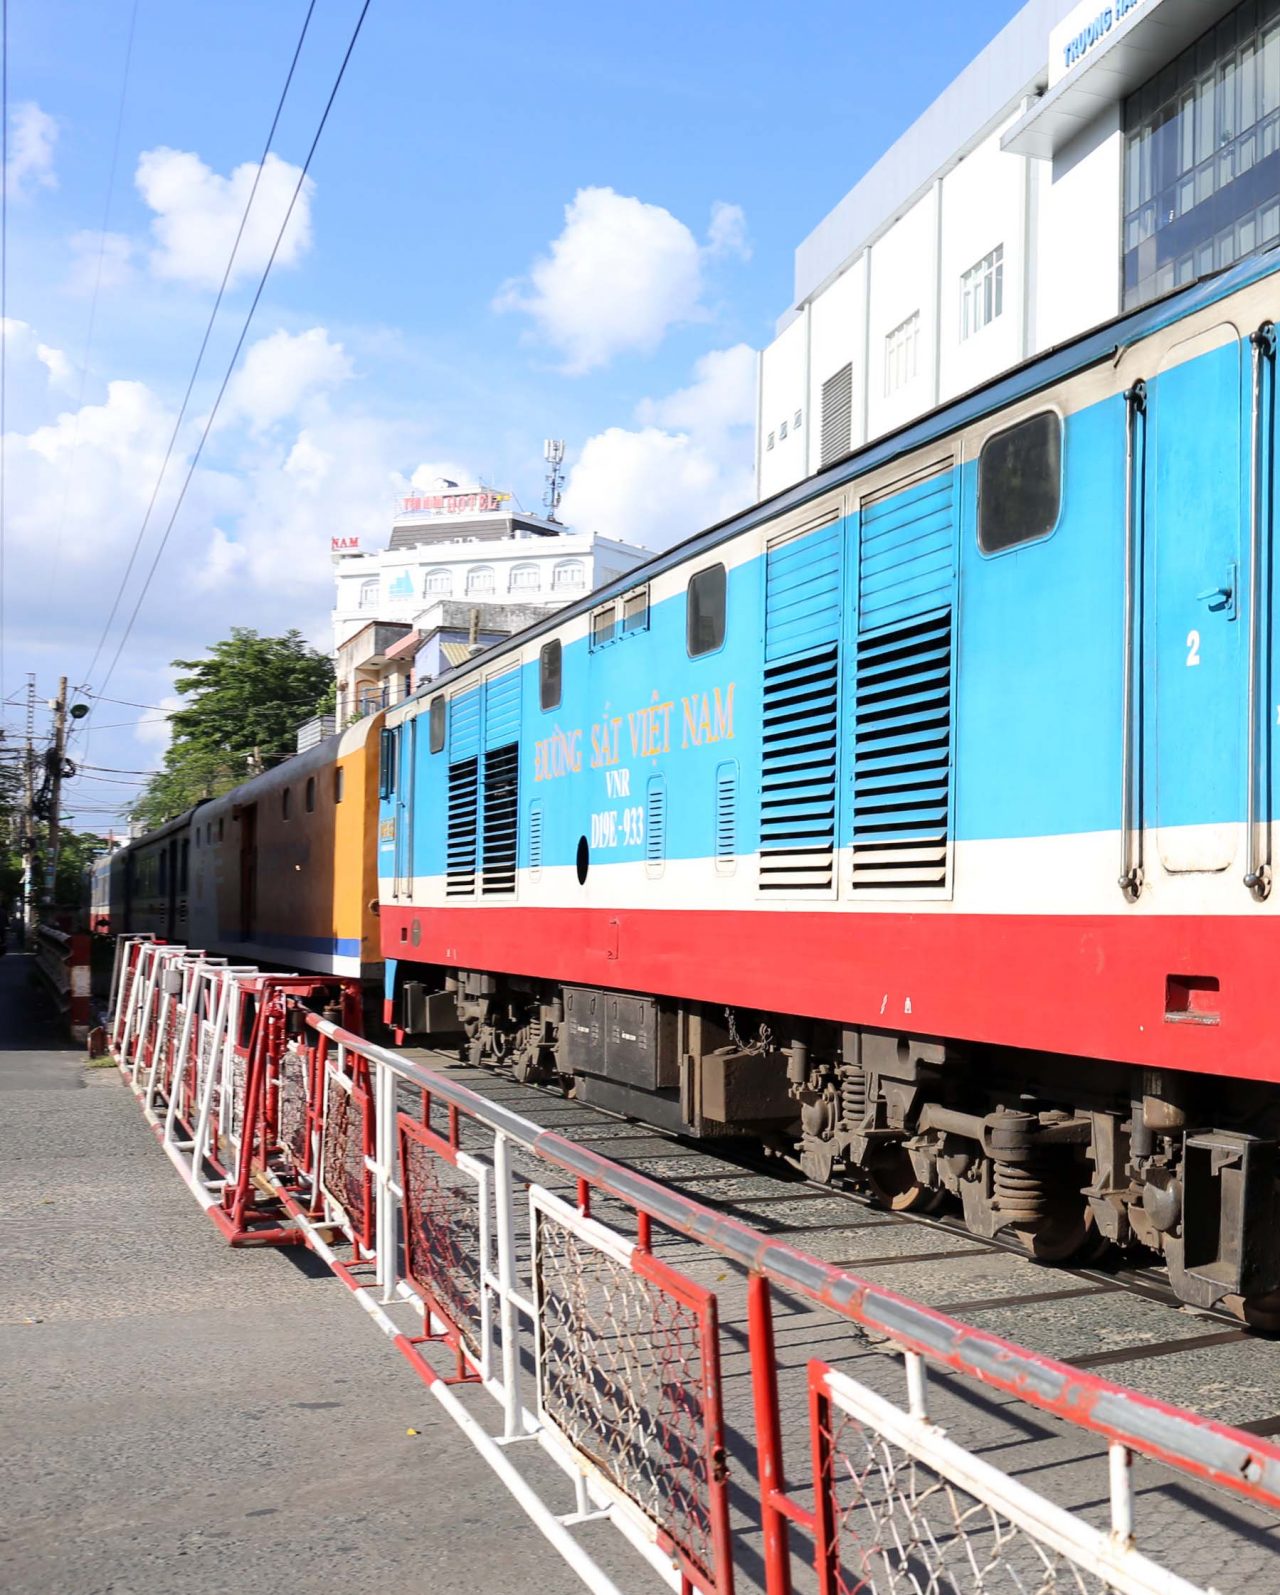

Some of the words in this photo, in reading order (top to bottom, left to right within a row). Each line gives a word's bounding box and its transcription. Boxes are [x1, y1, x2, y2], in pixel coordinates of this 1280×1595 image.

[331, 537, 359, 549] NAM
[1186, 630, 1201, 667] 2
[627, 690, 674, 767] VIỆT
[681, 682, 736, 750] NAM
[605, 768, 631, 799] VNR
